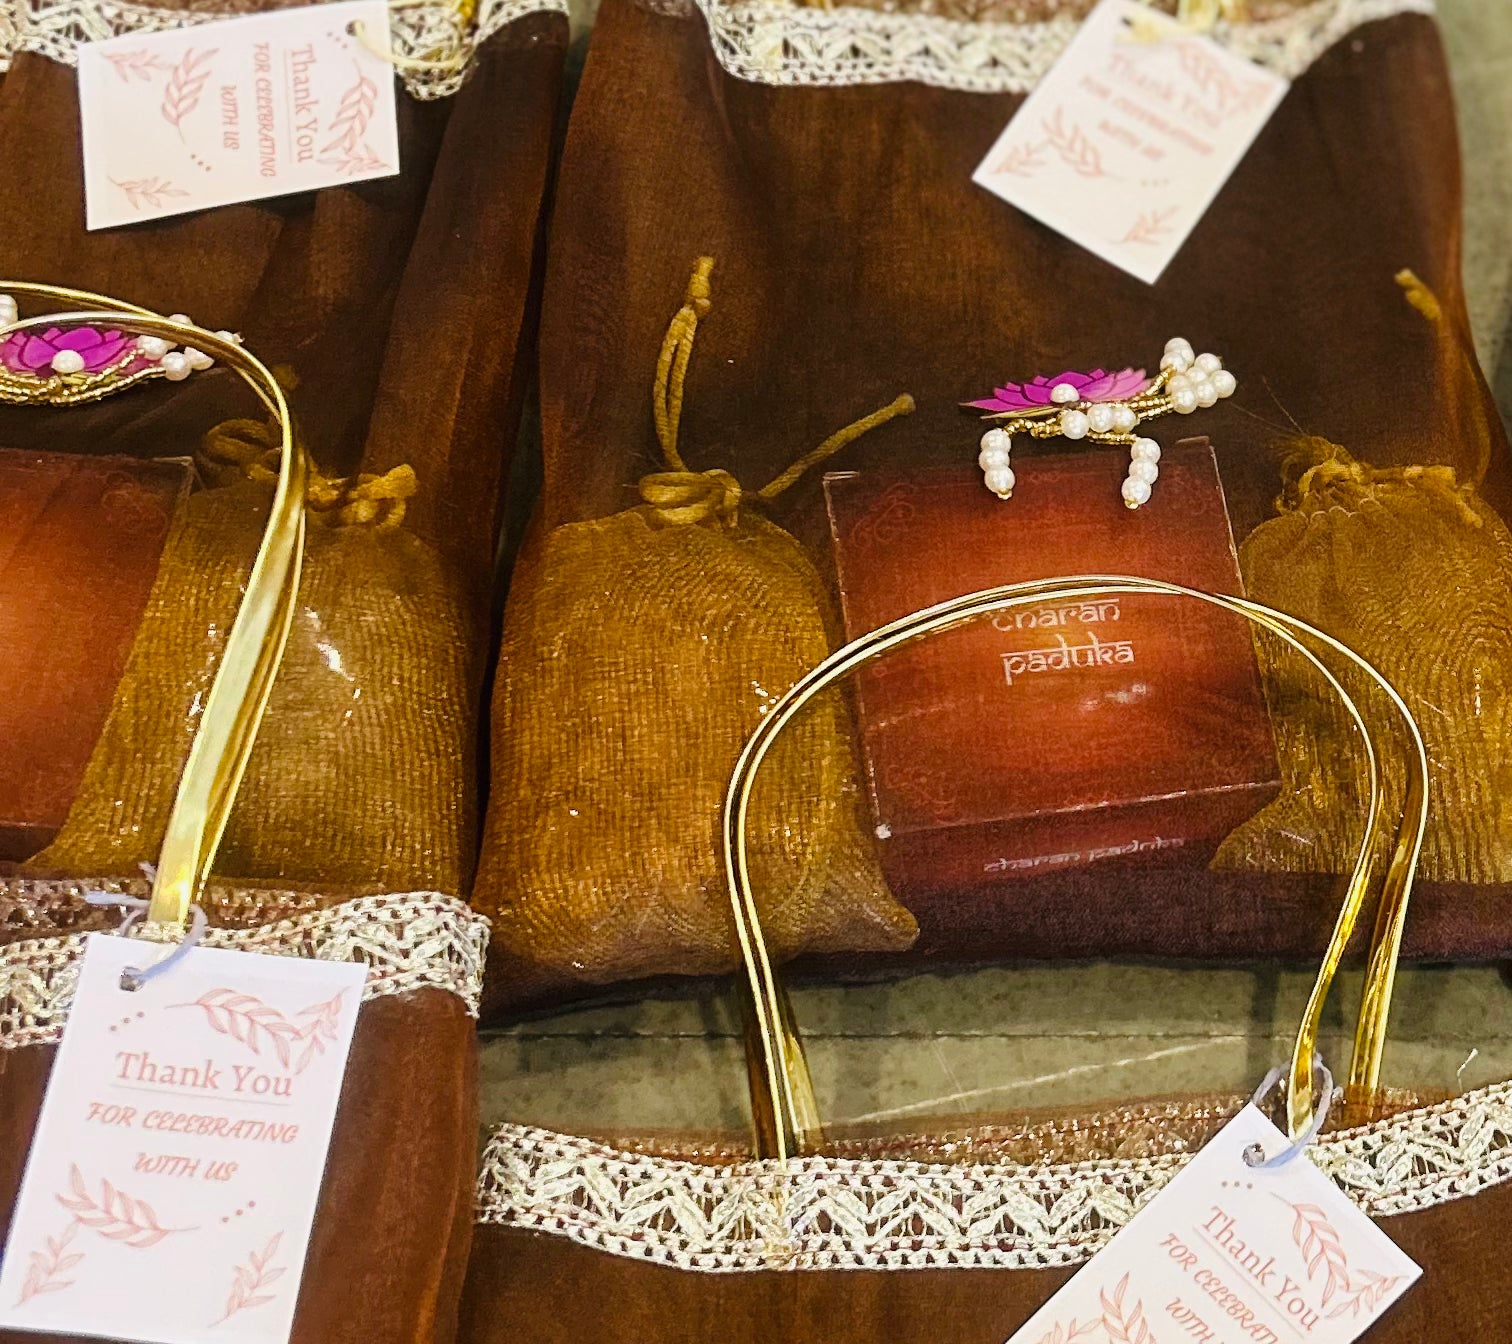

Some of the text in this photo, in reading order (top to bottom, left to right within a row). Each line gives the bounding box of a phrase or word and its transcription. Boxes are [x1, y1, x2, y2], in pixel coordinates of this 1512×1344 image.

[292, 43, 318, 163] Thank You
[1000, 631, 1135, 686] paduka
[116, 1050, 293, 1097] Thank You
[86, 1102, 299, 1145] FOR CELEBRATING
[133, 1152, 240, 1182] WITH US
[1159, 1232, 1200, 1274] FOR
[1202, 1206, 1320, 1333] Thank You
